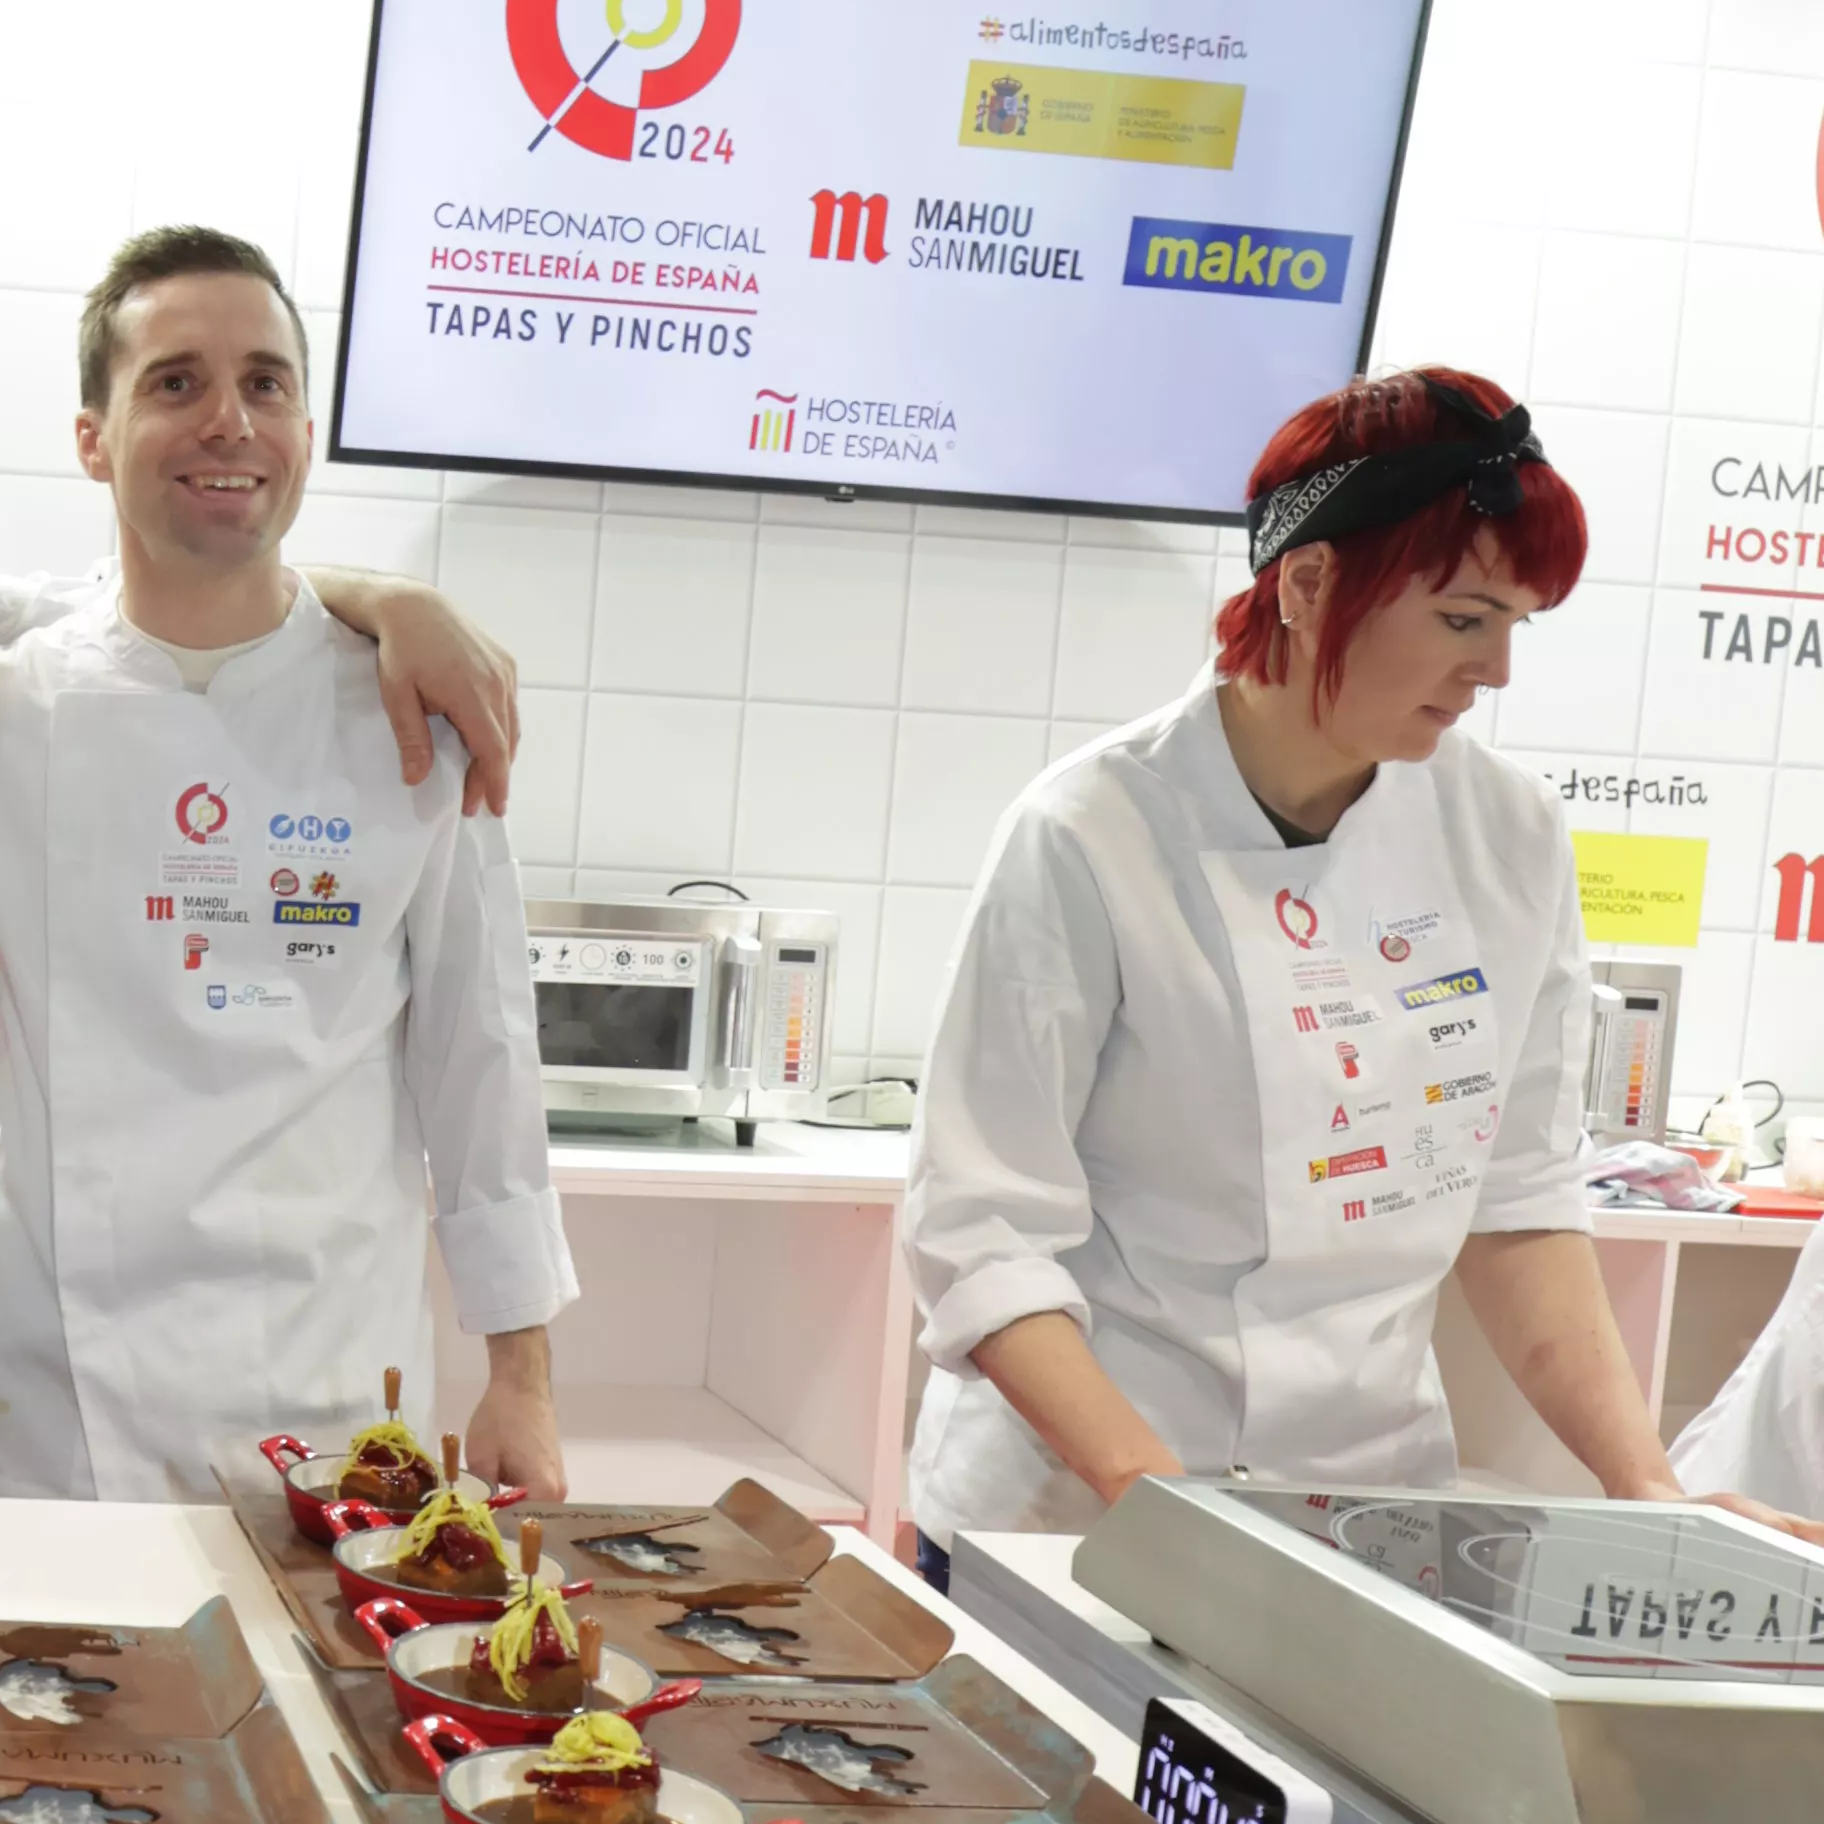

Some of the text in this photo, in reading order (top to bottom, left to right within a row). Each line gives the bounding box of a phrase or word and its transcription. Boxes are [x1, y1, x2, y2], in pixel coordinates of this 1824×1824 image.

[978, 16, 1248, 60] #alimentosdespaña
[639, 121, 734, 165] 2024
[434, 202, 766, 254] CAMPEONATO OFICIAL
[915, 197, 1034, 238] MAHOU
[430, 246, 760, 295] HOSTELERÍA DE ESPAÑA
[908, 235, 1084, 281] SANMIGUEL
[1145, 234, 1327, 291] makro
[426, 302, 753, 358] TAPAS Y PINCHOS
[806, 397, 957, 432] HOSTELERÍA
[802, 431, 939, 464] DE ESPAÑA
[183, 895, 229, 908] MAHOU
[280, 905, 353, 923] makro
[1650, 890, 1685, 904] PESCA
[182, 910, 250, 924] SANMIGUEL
[642, 953, 665, 966] 100
[1319, 999, 1355, 1016] MAHOU
[1403, 974, 1479, 1008] makro
[1442, 1070, 1492, 1091] GOBIERNO
[1443, 1089, 1459, 1102] DE
